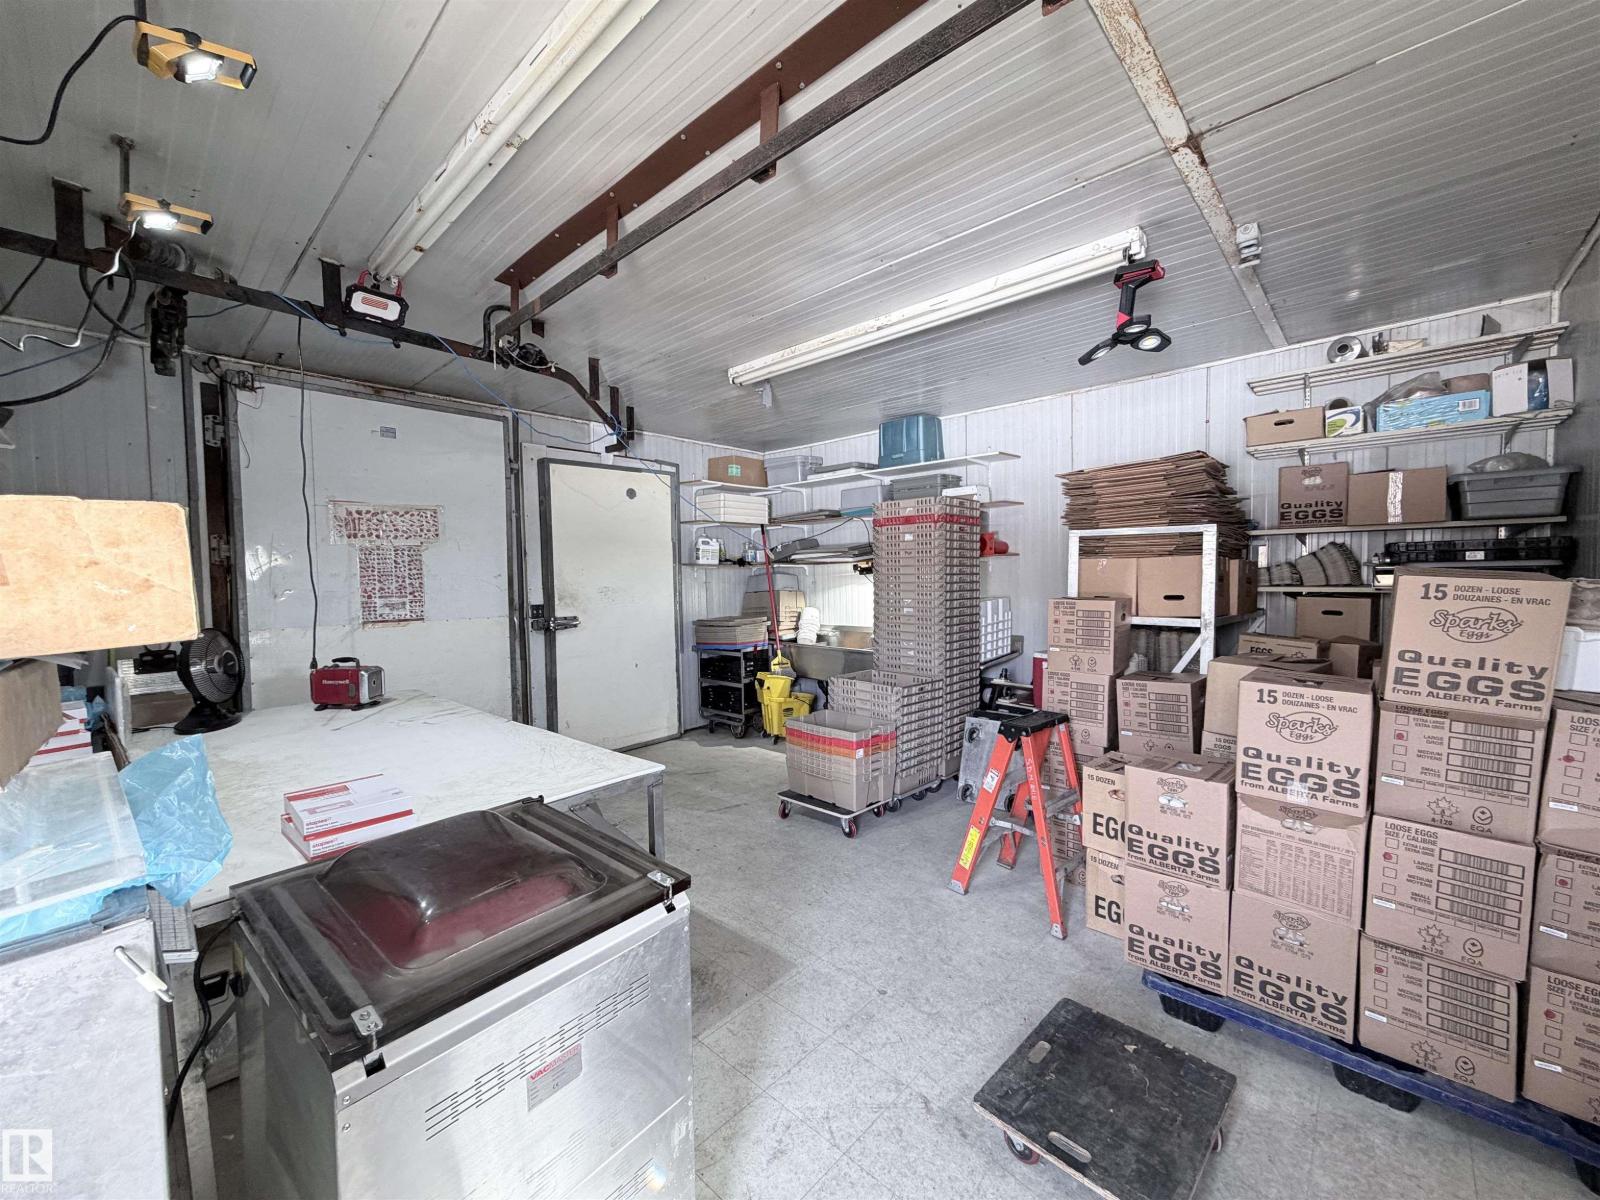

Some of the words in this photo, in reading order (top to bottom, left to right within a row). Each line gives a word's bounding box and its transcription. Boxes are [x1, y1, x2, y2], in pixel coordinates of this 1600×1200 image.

[1280, 508, 1344, 521] EGGS
[1281, 501, 1343, 509] Quality
[1420, 583, 1448, 601] 15
[1454, 585, 1483, 593] DOZEN
[1491, 586, 1521, 595] LOOSE
[1452, 594, 1502, 603] DOUZAINES
[1511, 597, 1524, 605] EN
[1525, 598, 1552, 606] VRAC
[1429, 609, 1523, 634] Sparks
[1459, 630, 1493, 640] Eggs
[1397, 649, 1549, 680] Quality
[1393, 666, 1546, 702] EGGS
[1257, 688, 1278, 704] 15
[1282, 691, 1305, 700] DOZEN
[1311, 695, 1334, 703] LOOSE
[1282, 699, 1320, 709] DOUZAINES
[1392, 686, 1422, 697] from
[1425, 691, 1490, 706] ALBERTA
[1495, 700, 1544, 712] Farms
[1265, 712, 1338, 737] Sparks
[1570, 724, 1590, 734] SIZE
[1289, 731, 1315, 741] Eggs
[1242, 746, 1361, 780] Quality
[1095, 775, 1116, 786] DOZEN
[1240, 761, 1361, 799] EGGS
[1240, 780, 1265, 790] from
[1322, 796, 1359, 809] Farms
[1384, 830, 1401, 838] SIZE
[1406, 835, 1438, 846] CALIBRE
[1385, 822, 1413, 834] LOOSE
[1414, 828, 1439, 840] EGGS
[1470, 824, 1493, 834] EQA
[1127, 824, 1221, 858] Quality
[1098, 859, 1119, 871] DOZEN
[1127, 837, 1221, 875] EGGS
[1127, 852, 1147, 863] from
[1148, 859, 1188, 876] ALBERTA
[1190, 870, 1220, 884] Farms
[1094, 894, 1125, 925] EG
[1128, 923, 1222, 963] Quality
[1127, 936, 1222, 980] EGGS
[1461, 956, 1483, 967] EQA
[1127, 952, 1147, 964] from
[1150, 959, 1190, 978] ALBERTA
[1192, 974, 1221, 989] Farms
[1235, 955, 1348, 1006] Quality
[1547, 975, 1582, 992] LOOSE
[1547, 984, 1566, 995] SIZE
[1234, 969, 1347, 1026] EGGS
[1233, 986, 1256, 1000] from
[1259, 996, 1308, 1020] ALBERTA
[1311, 1016, 1346, 1035] Farms
[1453, 1072, 1476, 1085] EQA
